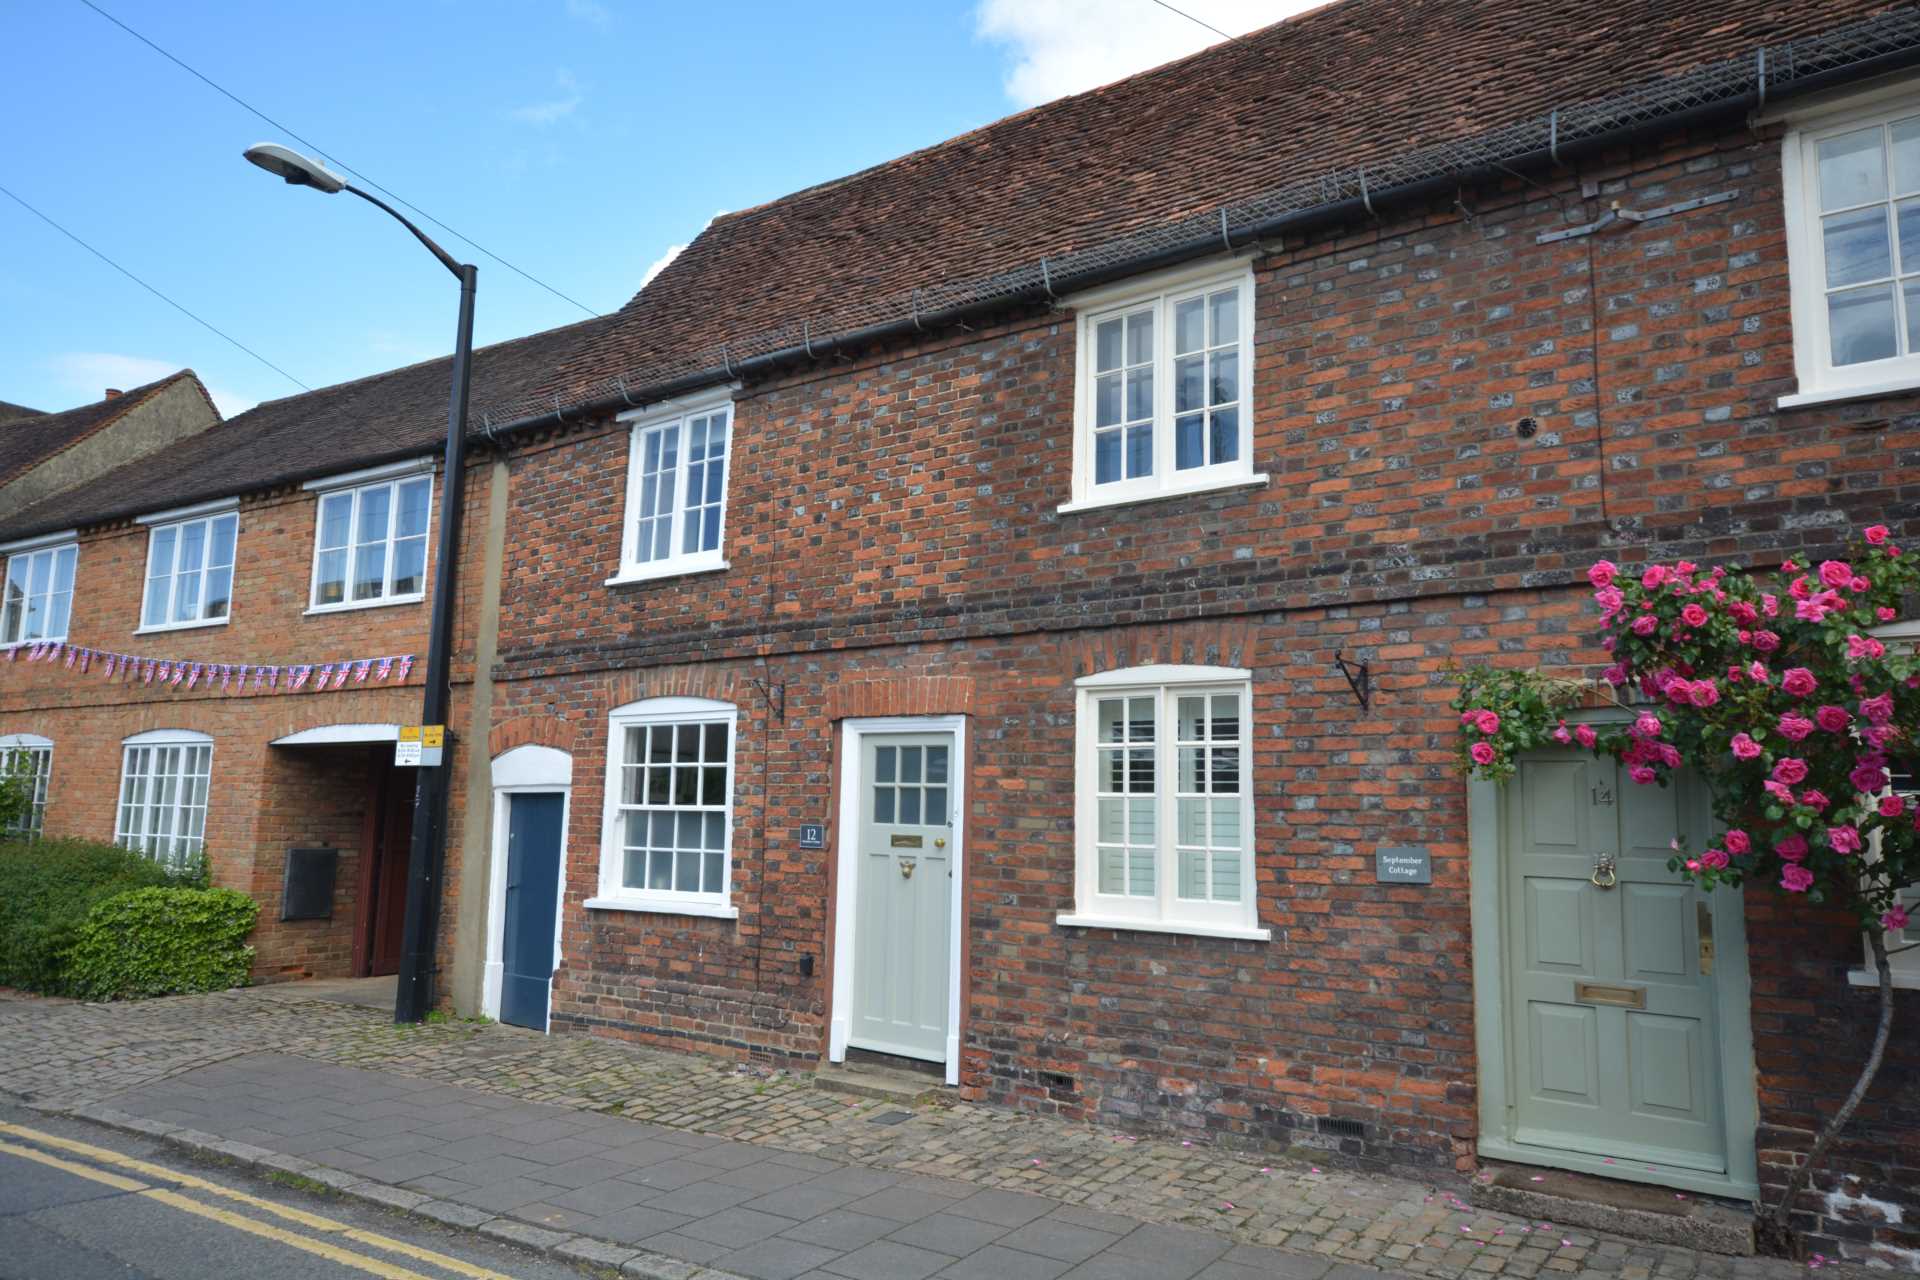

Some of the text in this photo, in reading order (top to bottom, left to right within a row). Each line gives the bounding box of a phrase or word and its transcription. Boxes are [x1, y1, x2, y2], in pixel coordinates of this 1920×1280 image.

[1592, 788, 1614, 806] 14
[807, 828, 817, 840] 12
[1382, 855, 1423, 865] September
[1388, 866, 1418, 876] Cottage
